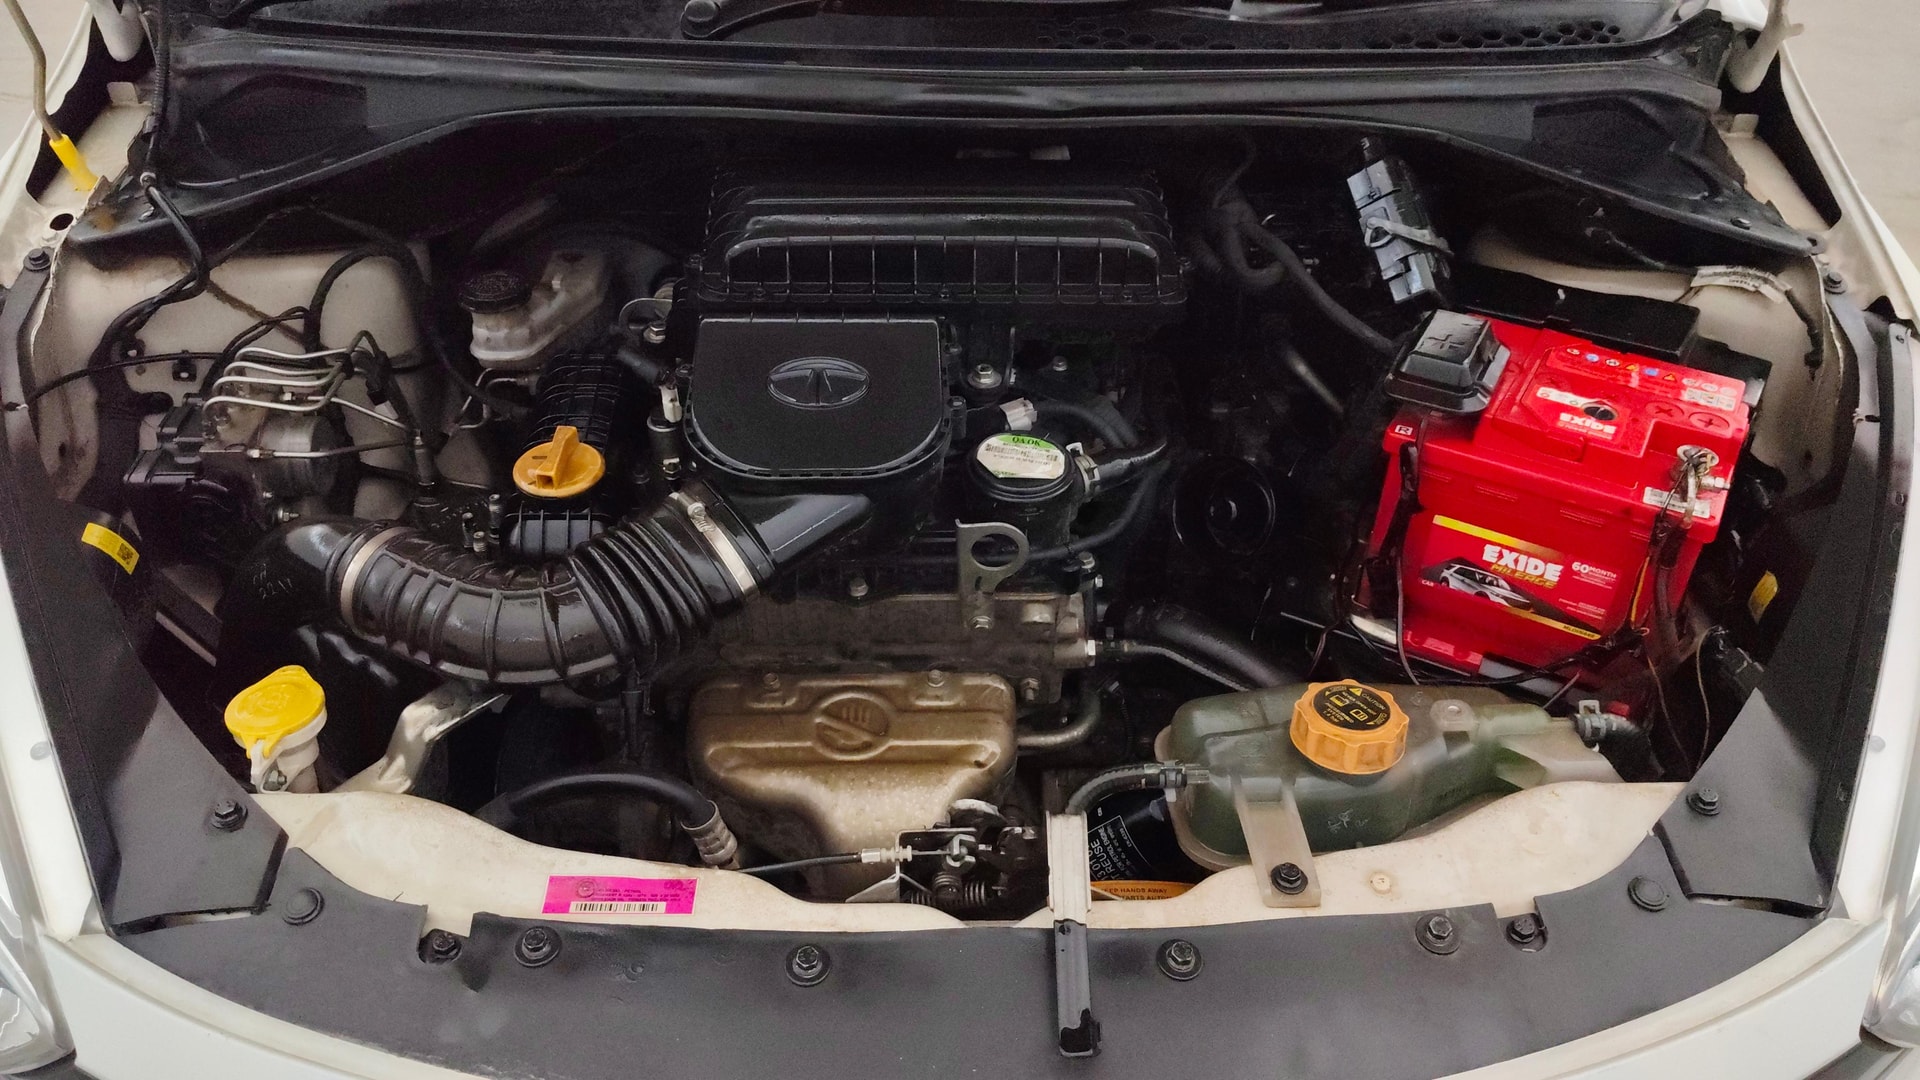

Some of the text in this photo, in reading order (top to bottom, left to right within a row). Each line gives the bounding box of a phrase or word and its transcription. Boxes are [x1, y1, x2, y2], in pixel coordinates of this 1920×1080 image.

[1559, 412, 1617, 434] EXIDE
[1482, 544, 1564, 582] EXIDE
[1572, 561, 1590, 573] 60
[1589, 566, 1617, 578] MONTH
[1421, 579, 1434, 587] CAR
[1490, 563, 1558, 589] MILEAGE
[1361, 693, 1386, 710] CAUTION
[1090, 838, 1116, 874] REUSE
